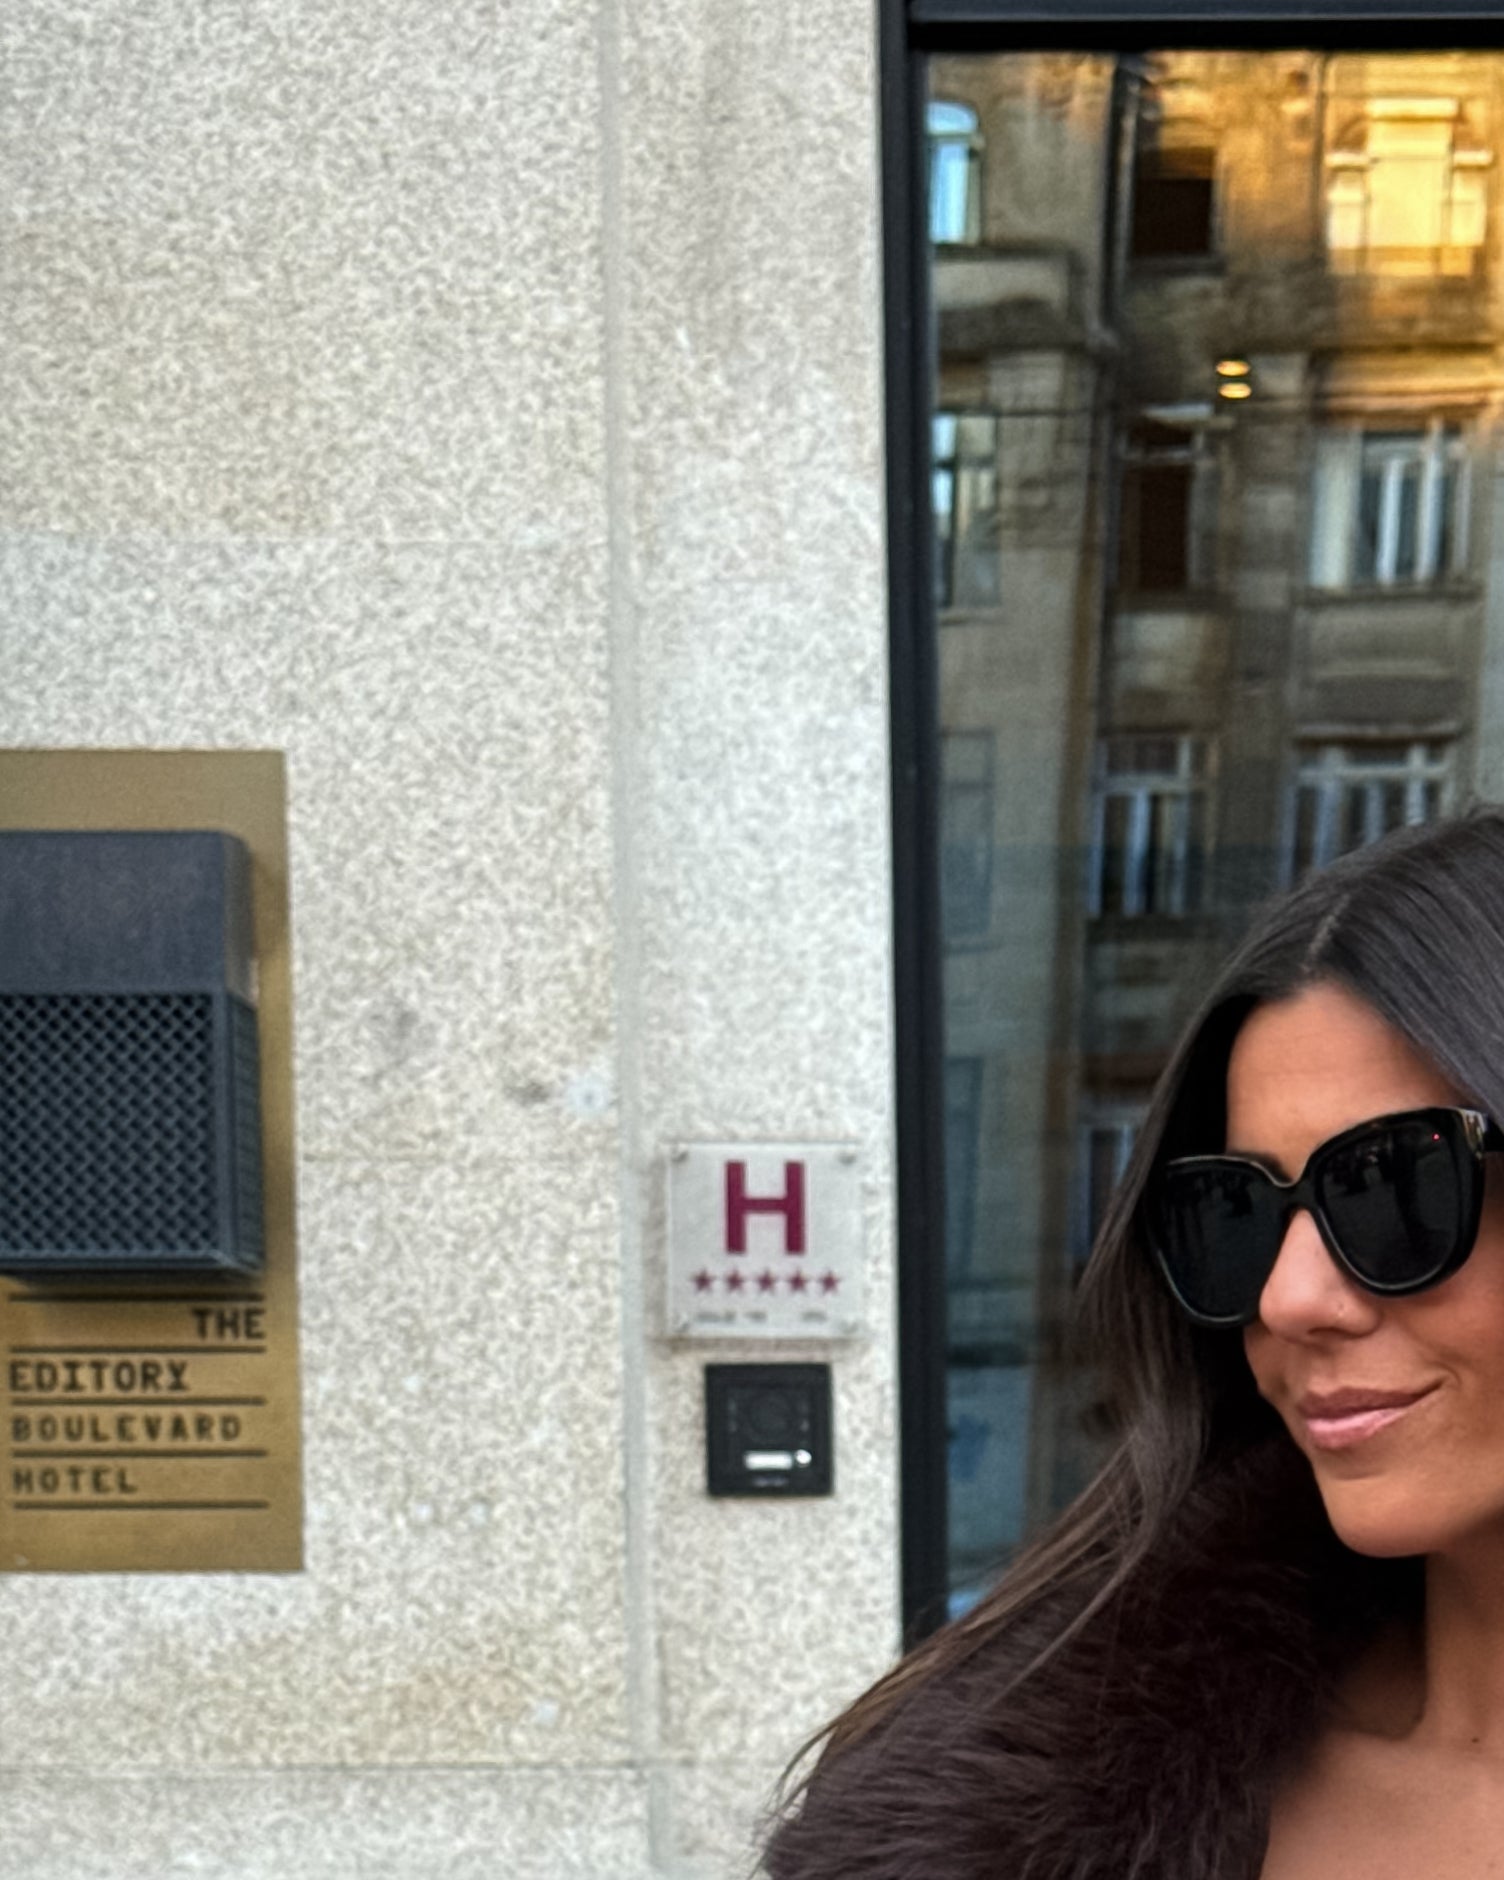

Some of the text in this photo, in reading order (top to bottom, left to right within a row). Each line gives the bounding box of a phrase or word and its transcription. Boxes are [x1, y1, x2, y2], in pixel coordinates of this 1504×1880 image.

[725, 1160, 805, 1256] H
[192, 1307, 266, 1340] THE
[9, 1360, 190, 1393] EDITORY
[11, 1414, 242, 1443] BOULEVARD
[12, 1466, 138, 1494] HOTEL
